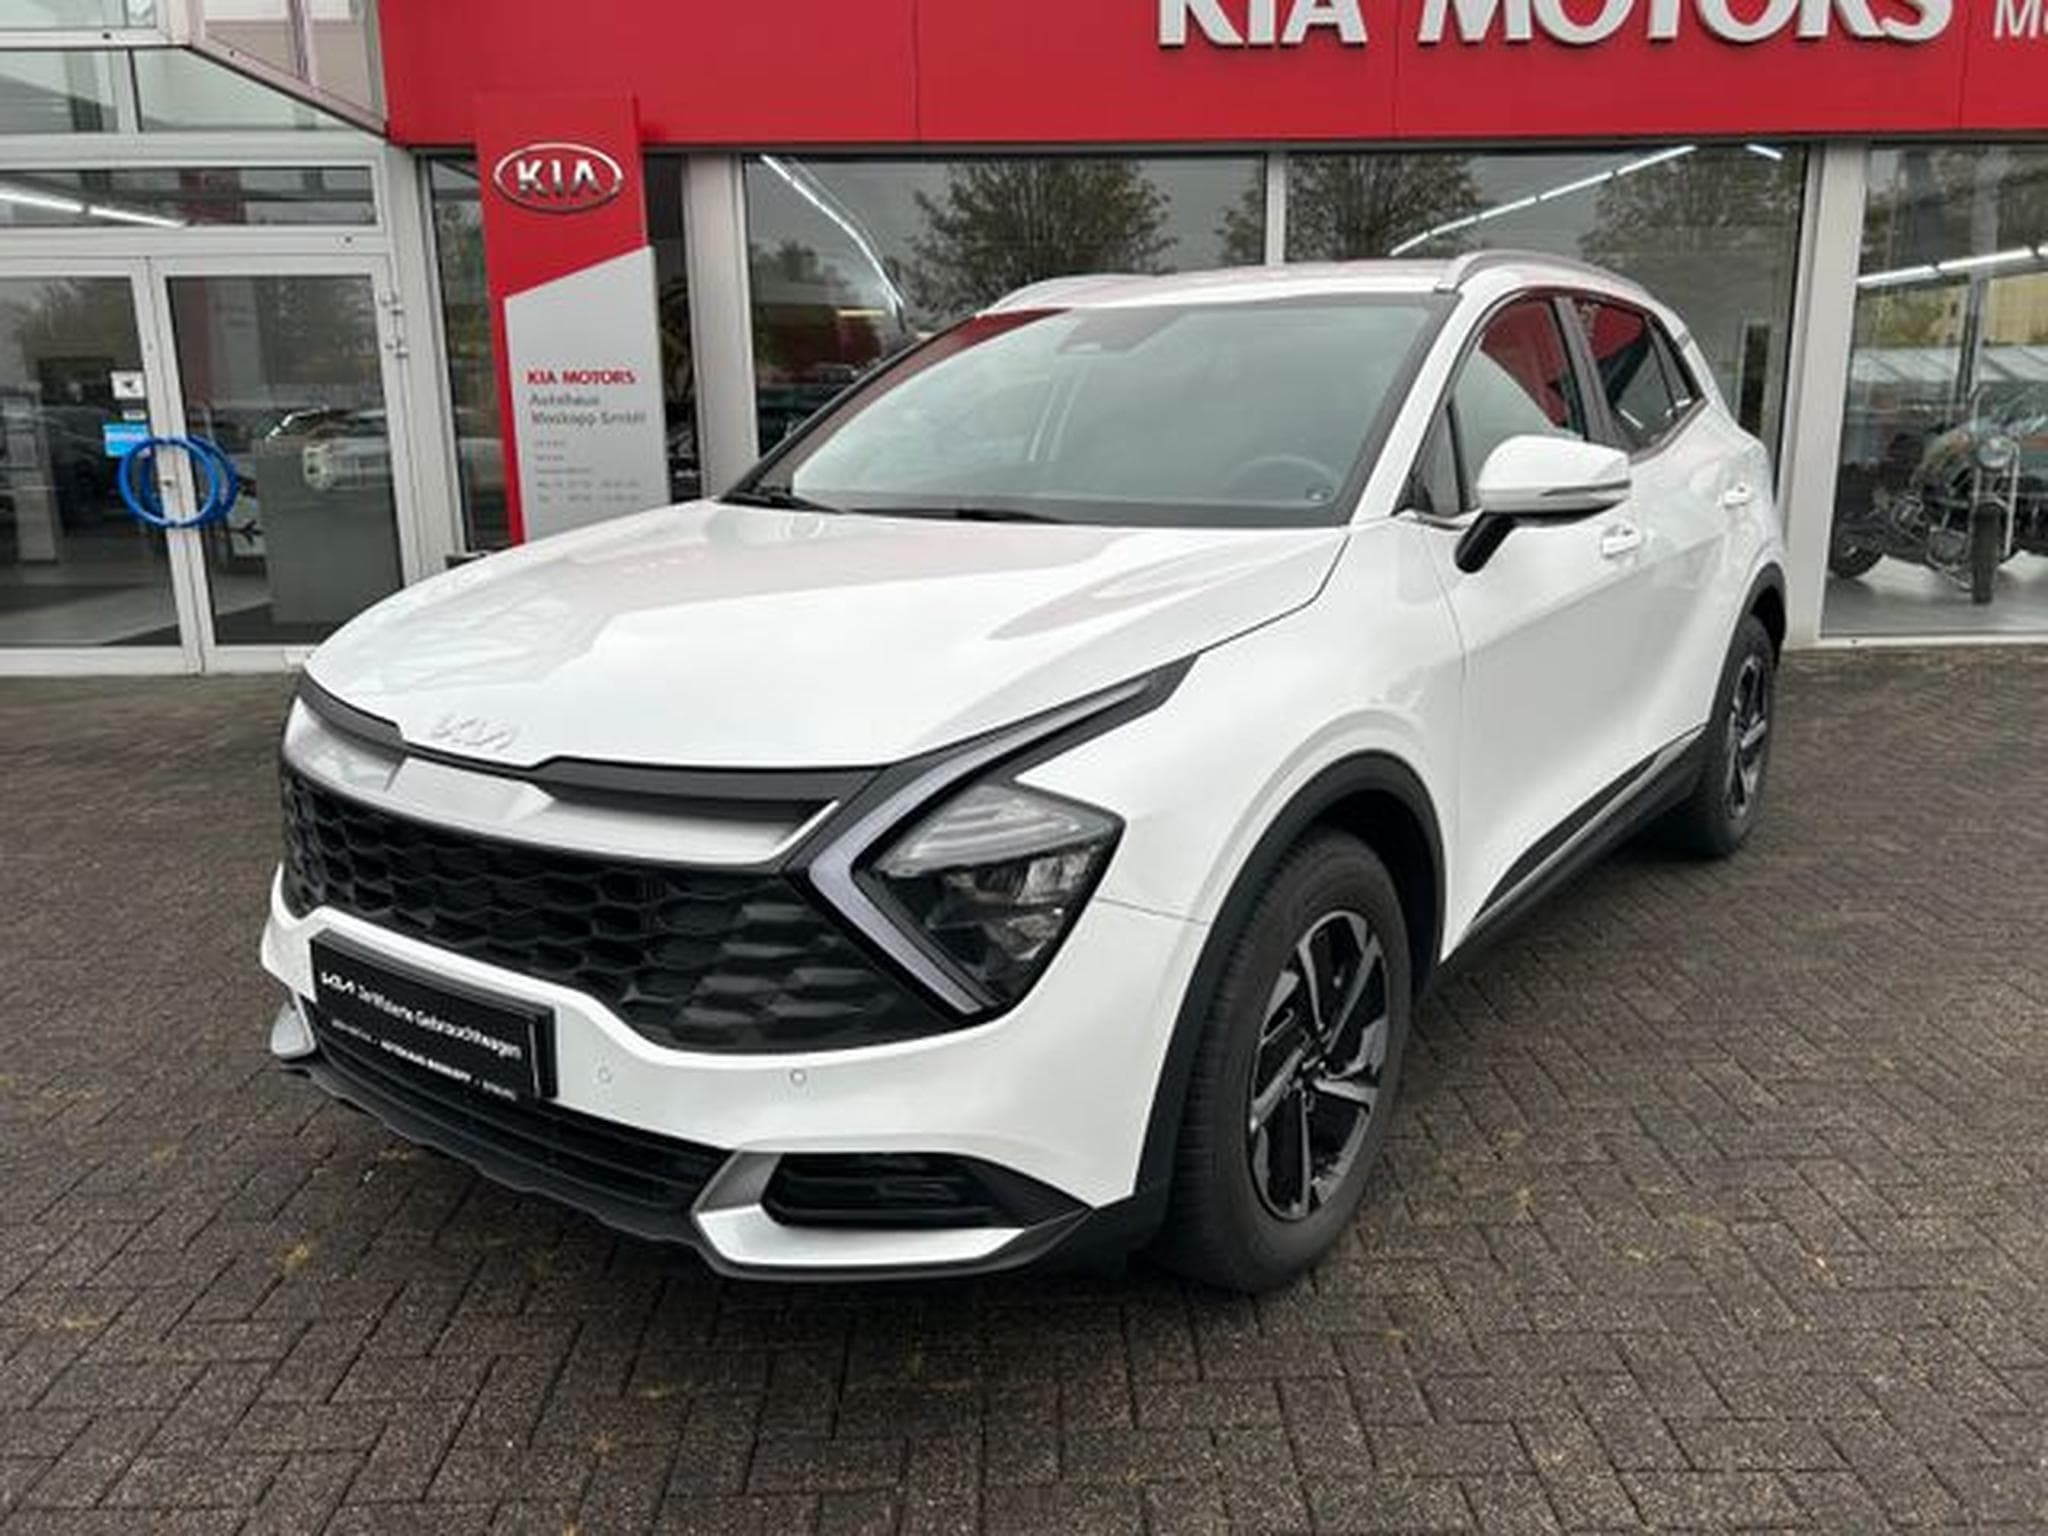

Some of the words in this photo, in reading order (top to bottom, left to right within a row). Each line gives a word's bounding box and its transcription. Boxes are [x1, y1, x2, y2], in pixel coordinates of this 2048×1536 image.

[1158, 0, 1369, 47] KIA
[517, 159, 601, 196] KIA
[527, 370, 558, 384] KIA
[562, 369, 636, 384] MOTORS
